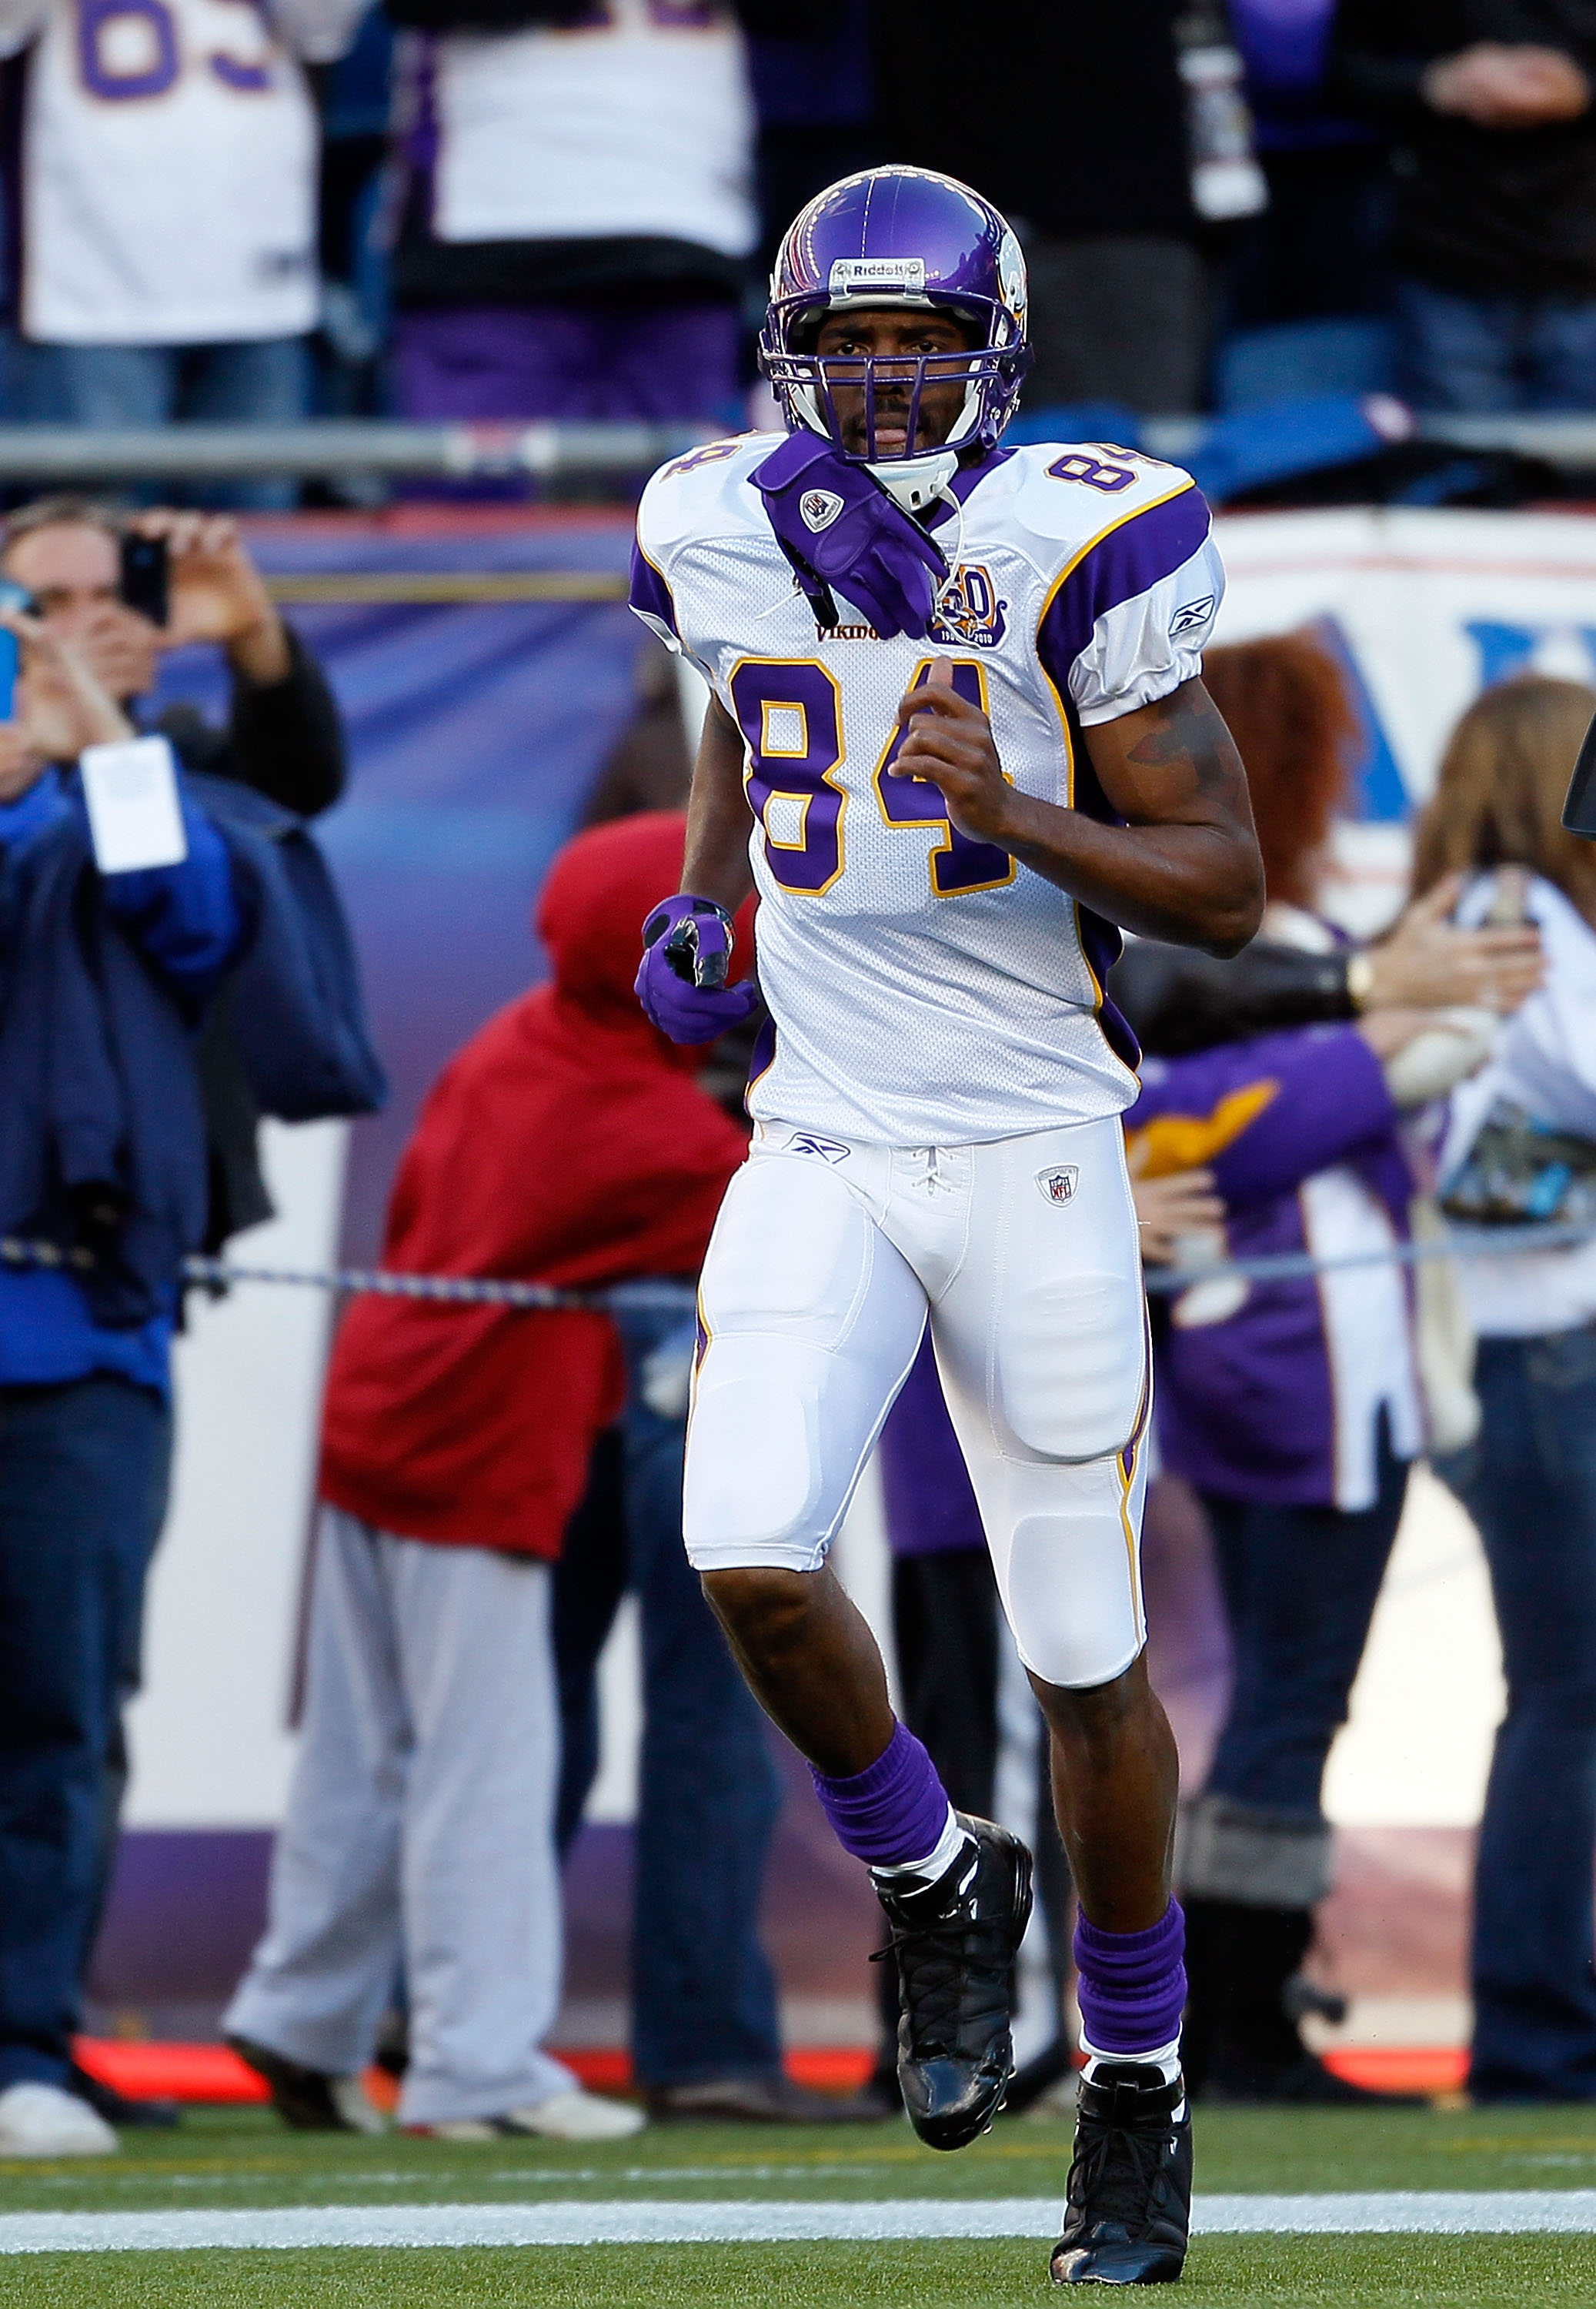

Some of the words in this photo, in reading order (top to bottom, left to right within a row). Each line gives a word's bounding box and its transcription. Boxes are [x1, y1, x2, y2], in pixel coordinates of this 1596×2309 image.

[973, 633, 993, 643] 2010
[728, 657, 1017, 898] 84
[1052, 1185, 1071, 1198] NFL
